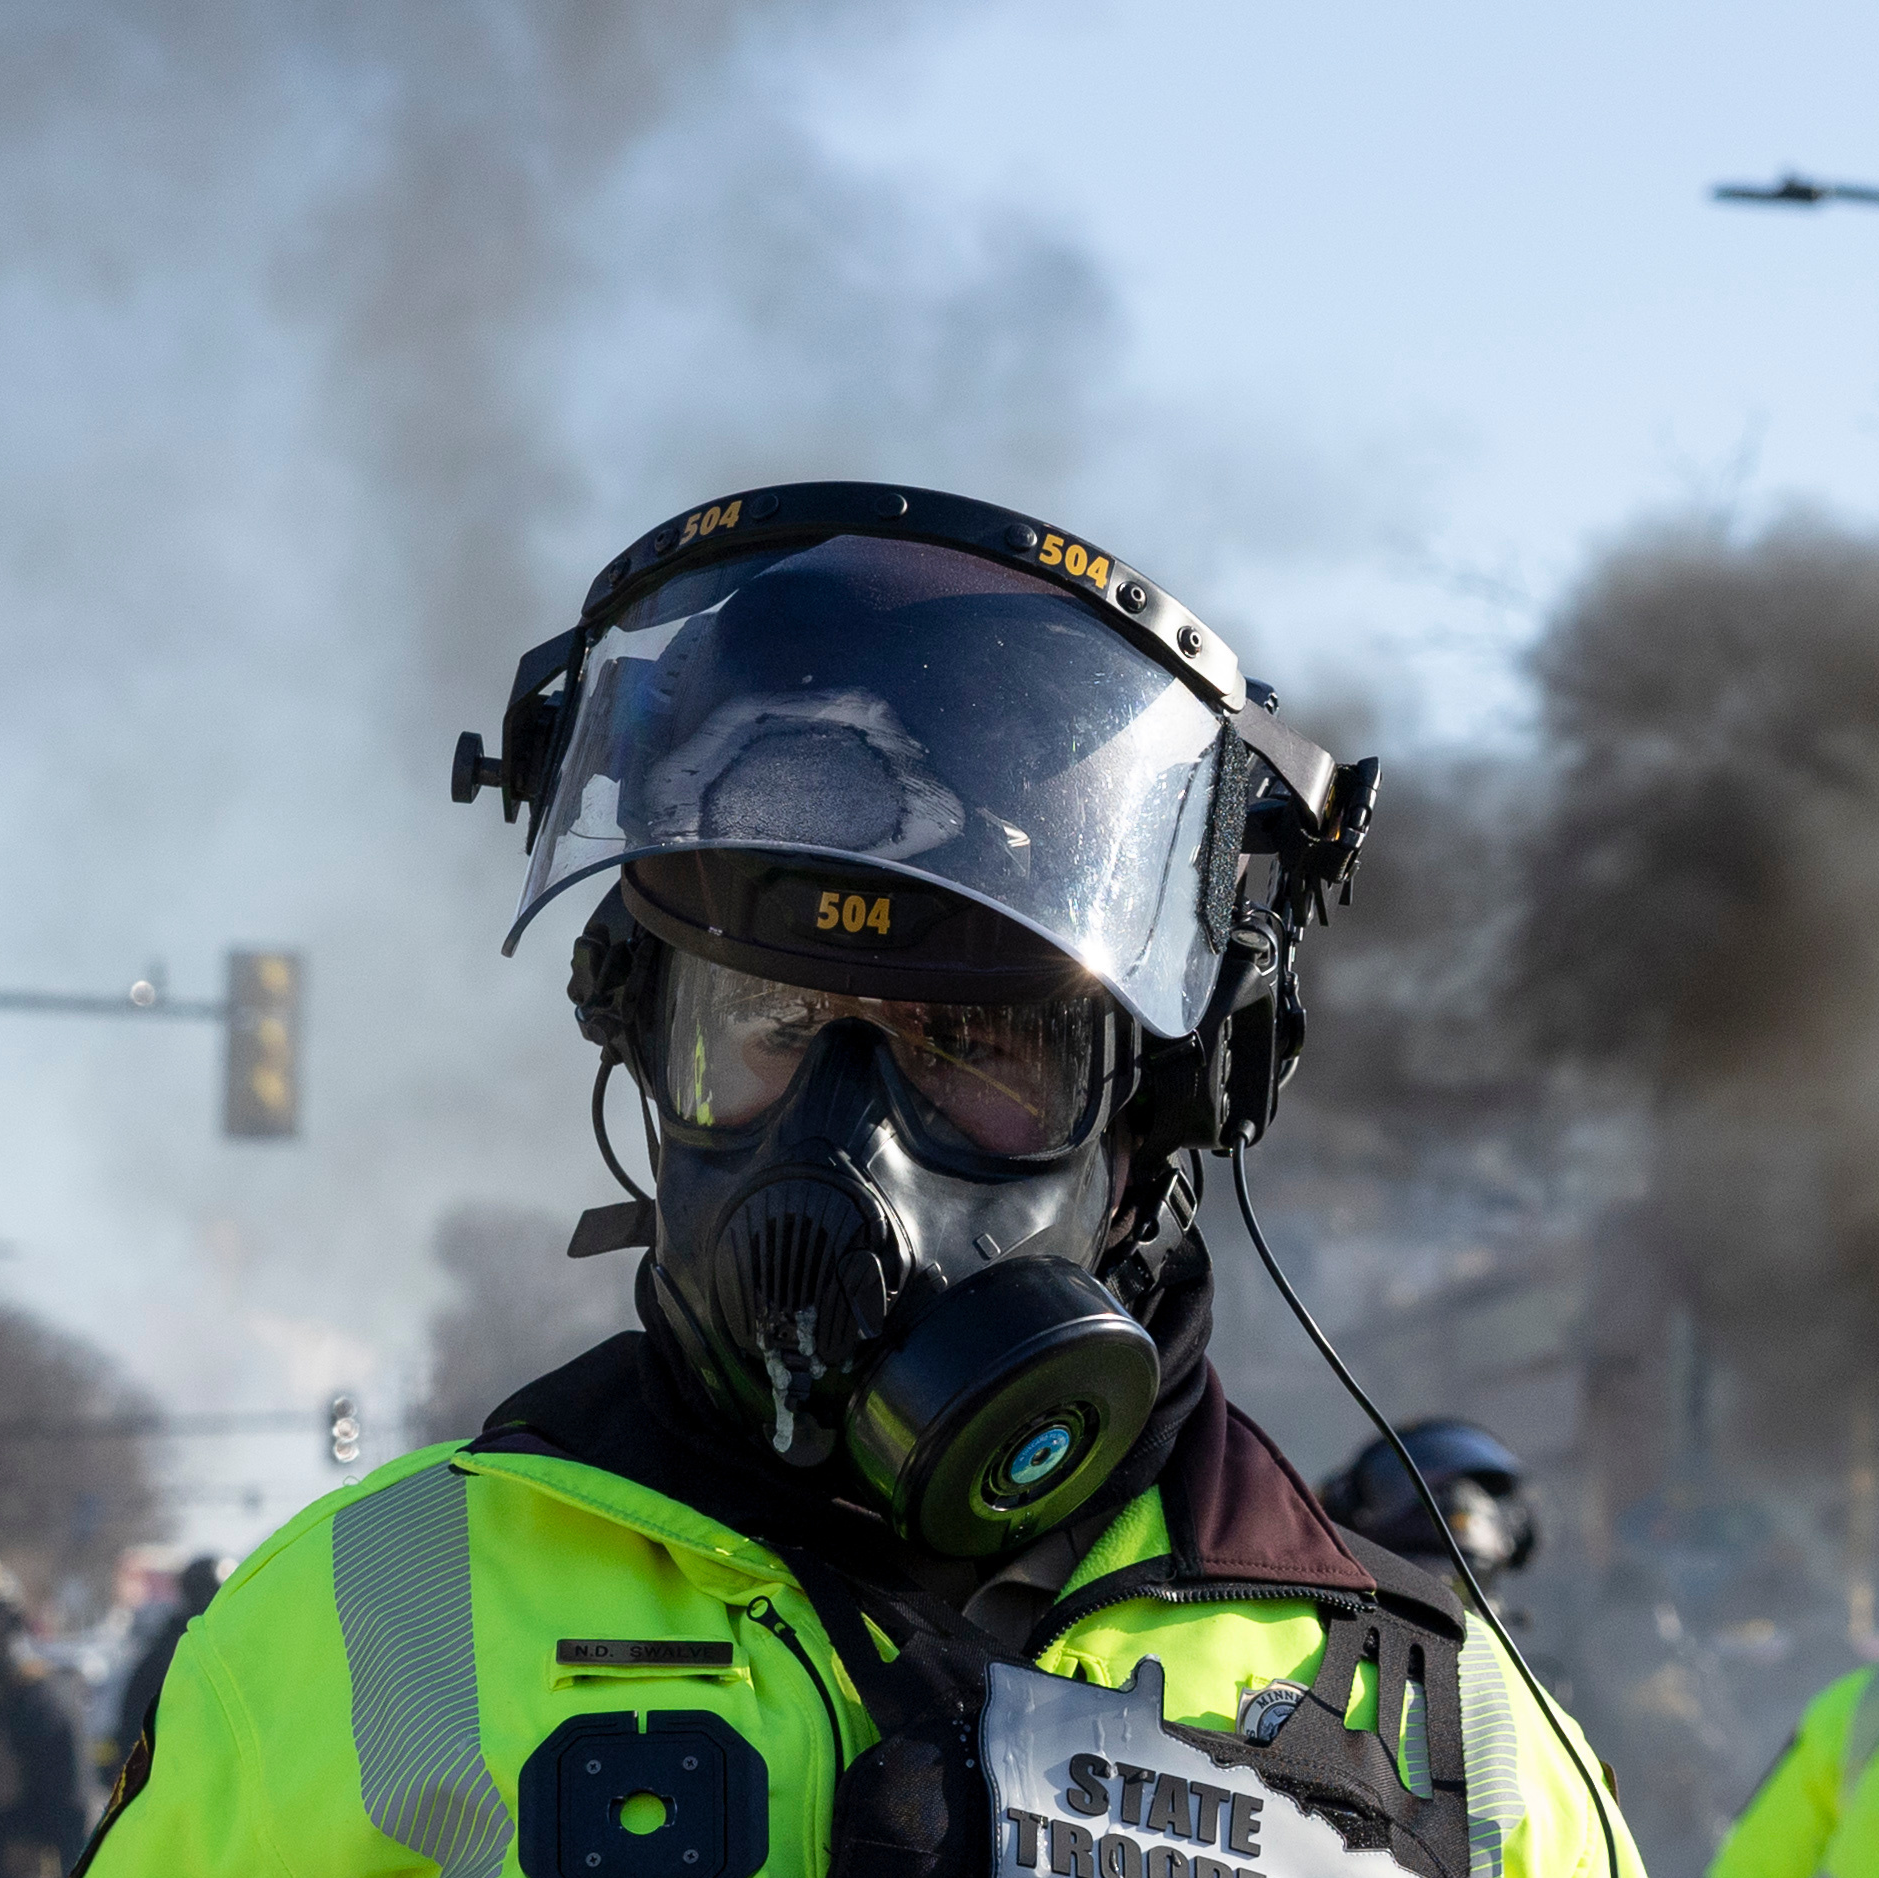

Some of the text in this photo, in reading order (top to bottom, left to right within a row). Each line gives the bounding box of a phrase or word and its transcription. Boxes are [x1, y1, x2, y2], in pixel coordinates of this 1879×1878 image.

[679, 499, 743, 541] 504
[1038, 533, 1111, 589] 504
[816, 891, 892, 936] 504
[575, 1645, 615, 1659] N.D.
[1065, 1752, 1264, 1857] STATE
